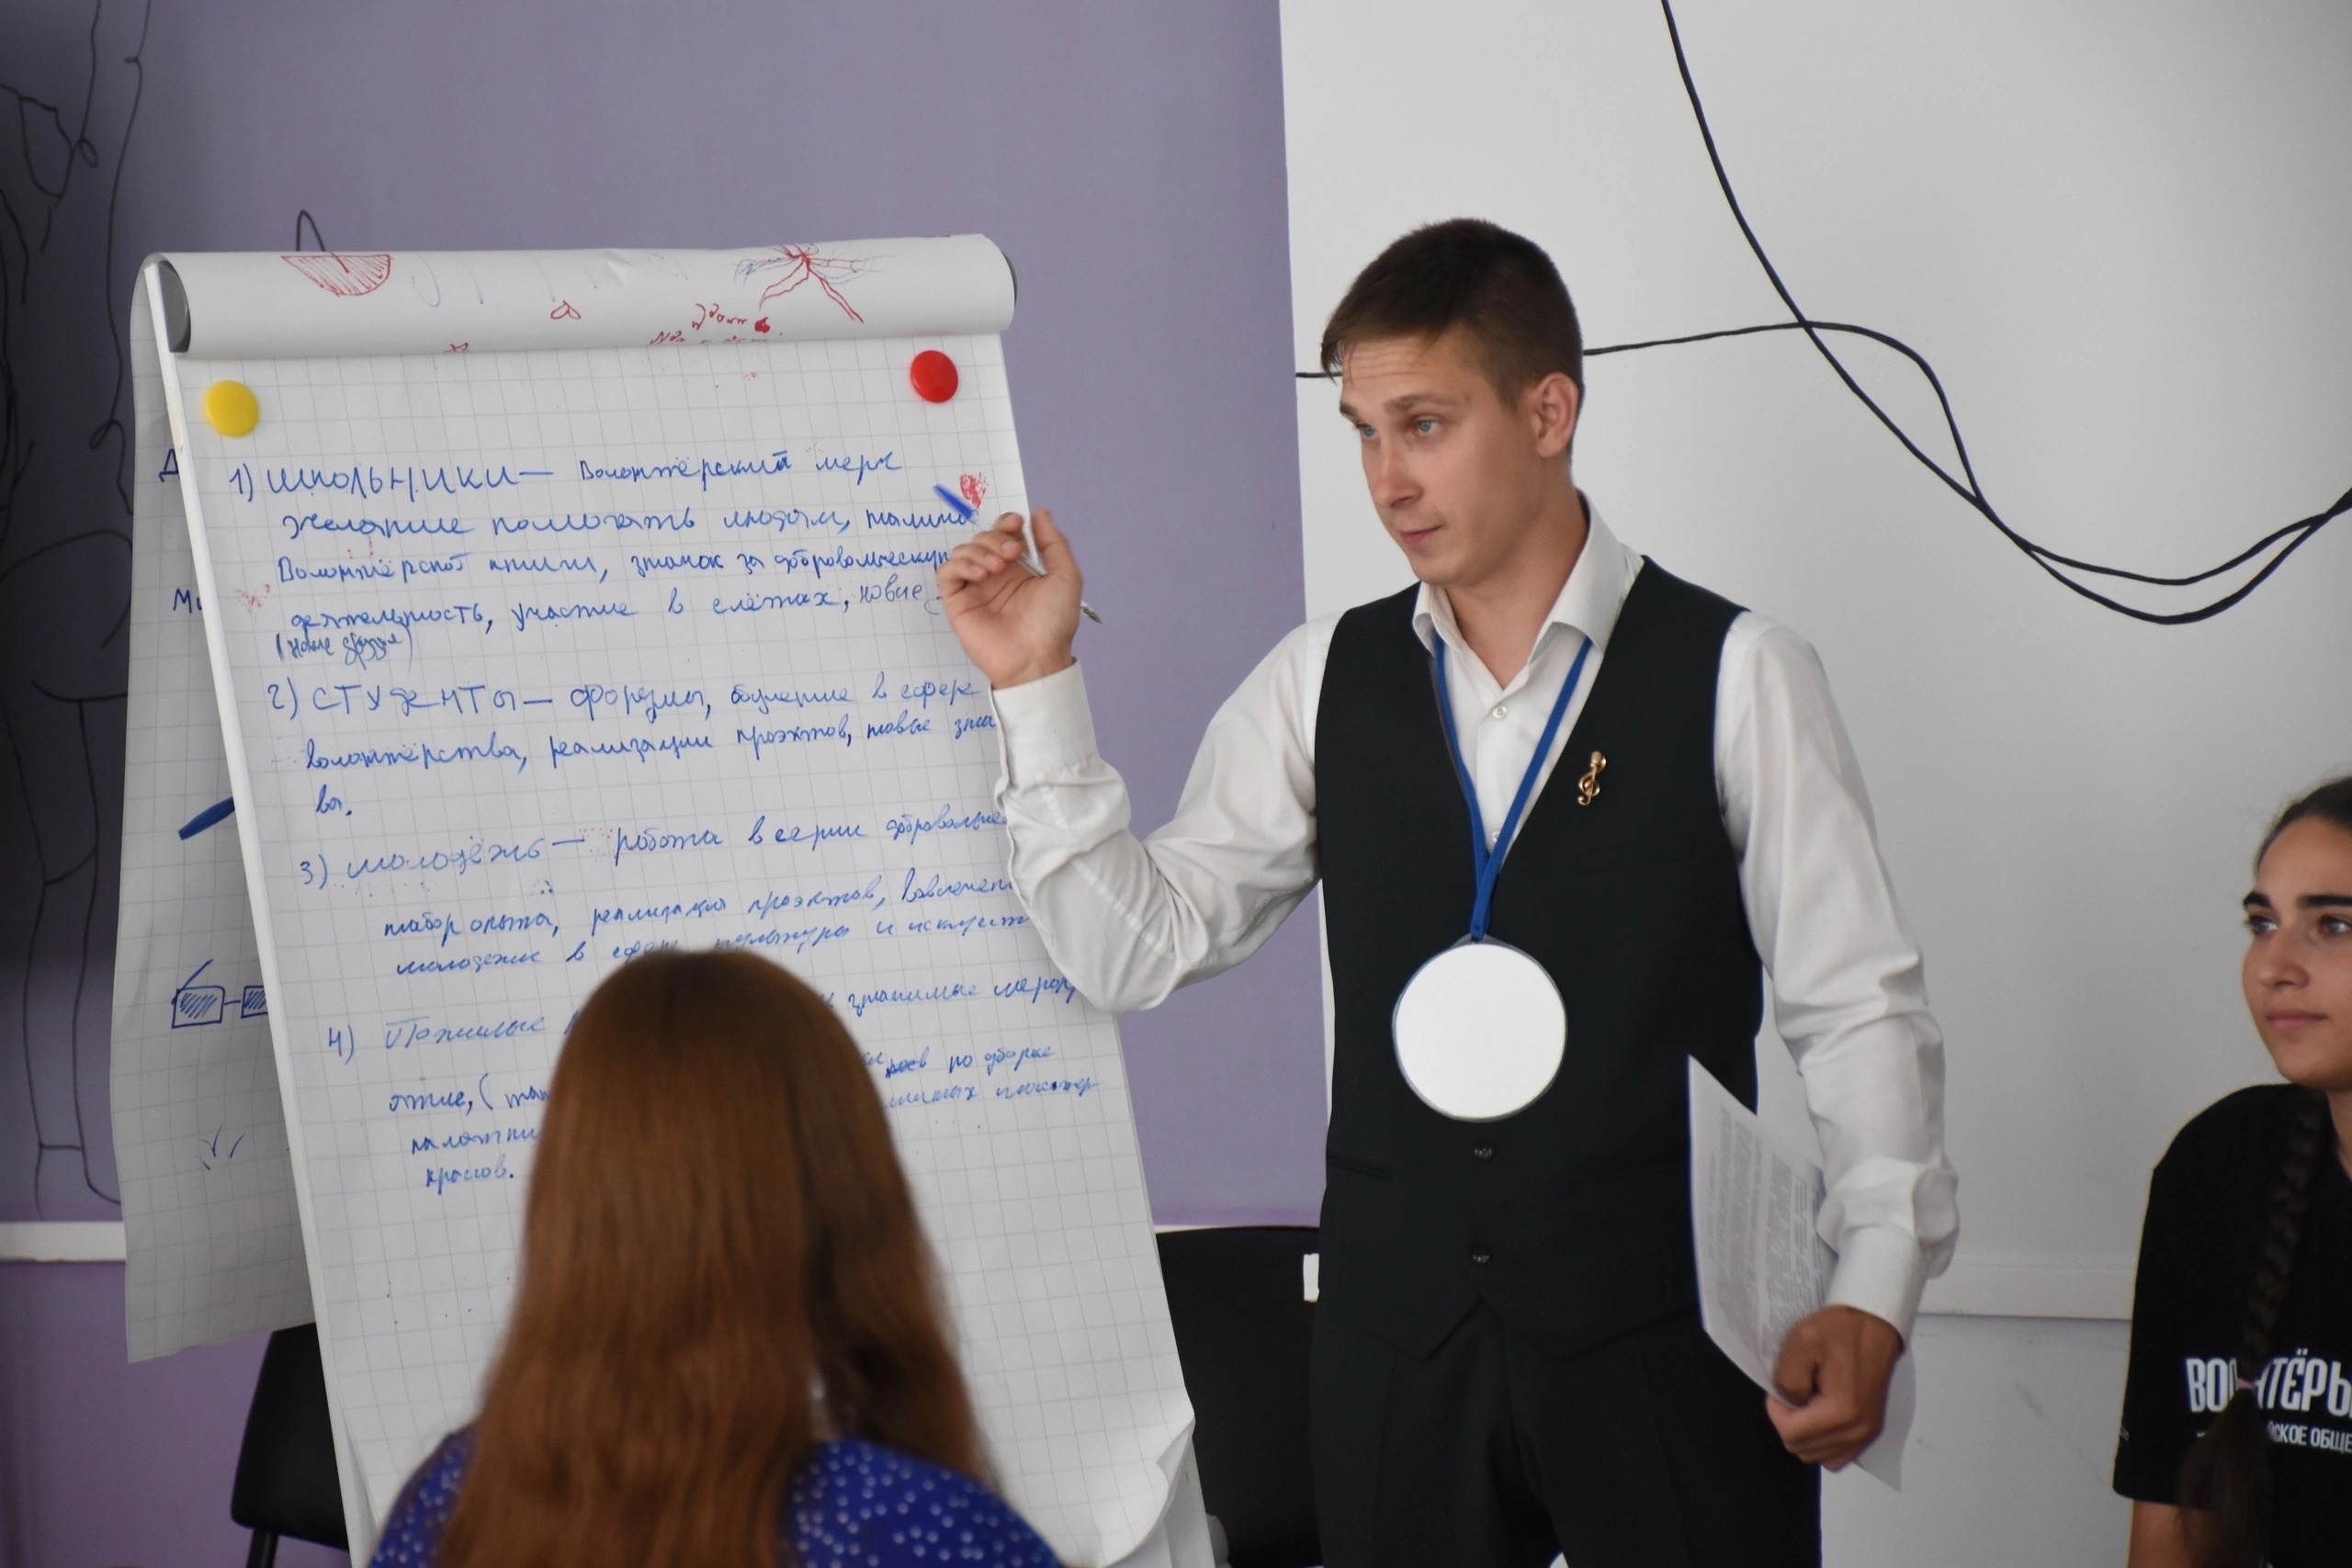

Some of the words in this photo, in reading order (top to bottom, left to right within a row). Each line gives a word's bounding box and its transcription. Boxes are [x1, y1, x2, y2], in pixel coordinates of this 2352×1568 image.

[228, 462, 254, 503] 1)
[865, 507, 974, 530] наличи
[666, 586, 684, 615] в
[872, 671, 888, 700] в
[300, 853, 329, 891] 3)
[900, 866, 1014, 904] вовлечен
